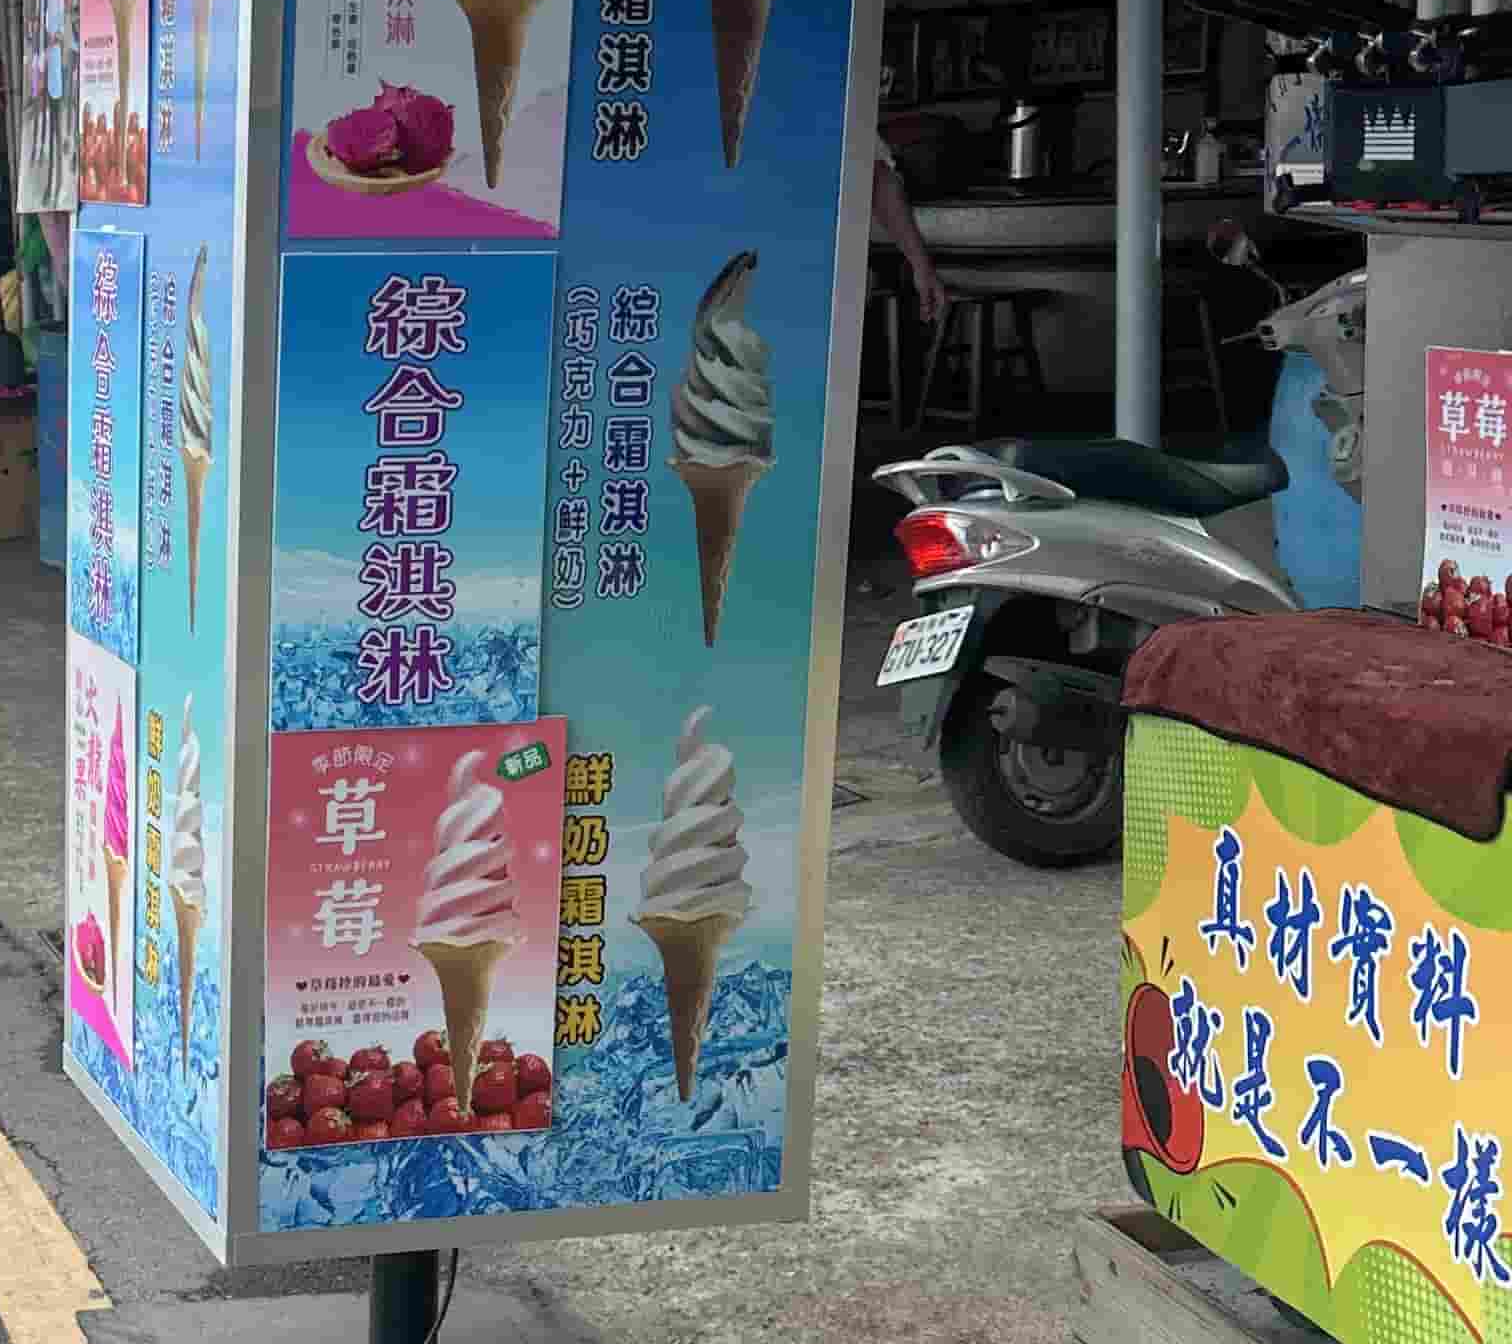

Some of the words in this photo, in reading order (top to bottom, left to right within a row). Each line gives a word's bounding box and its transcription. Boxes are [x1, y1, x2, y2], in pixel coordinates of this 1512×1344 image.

[357, 274, 468, 707] 綜合霜淇淋
[595, 285, 661, 599] 綜合霜淇淋
[1438, 390, 1507, 448] 草莓
[555, 753, 614, 1046] 鮮奶霜淇淋
[1198, 824, 1480, 1079] 真材實料
[1168, 976, 1512, 1288] 就是不一樣
